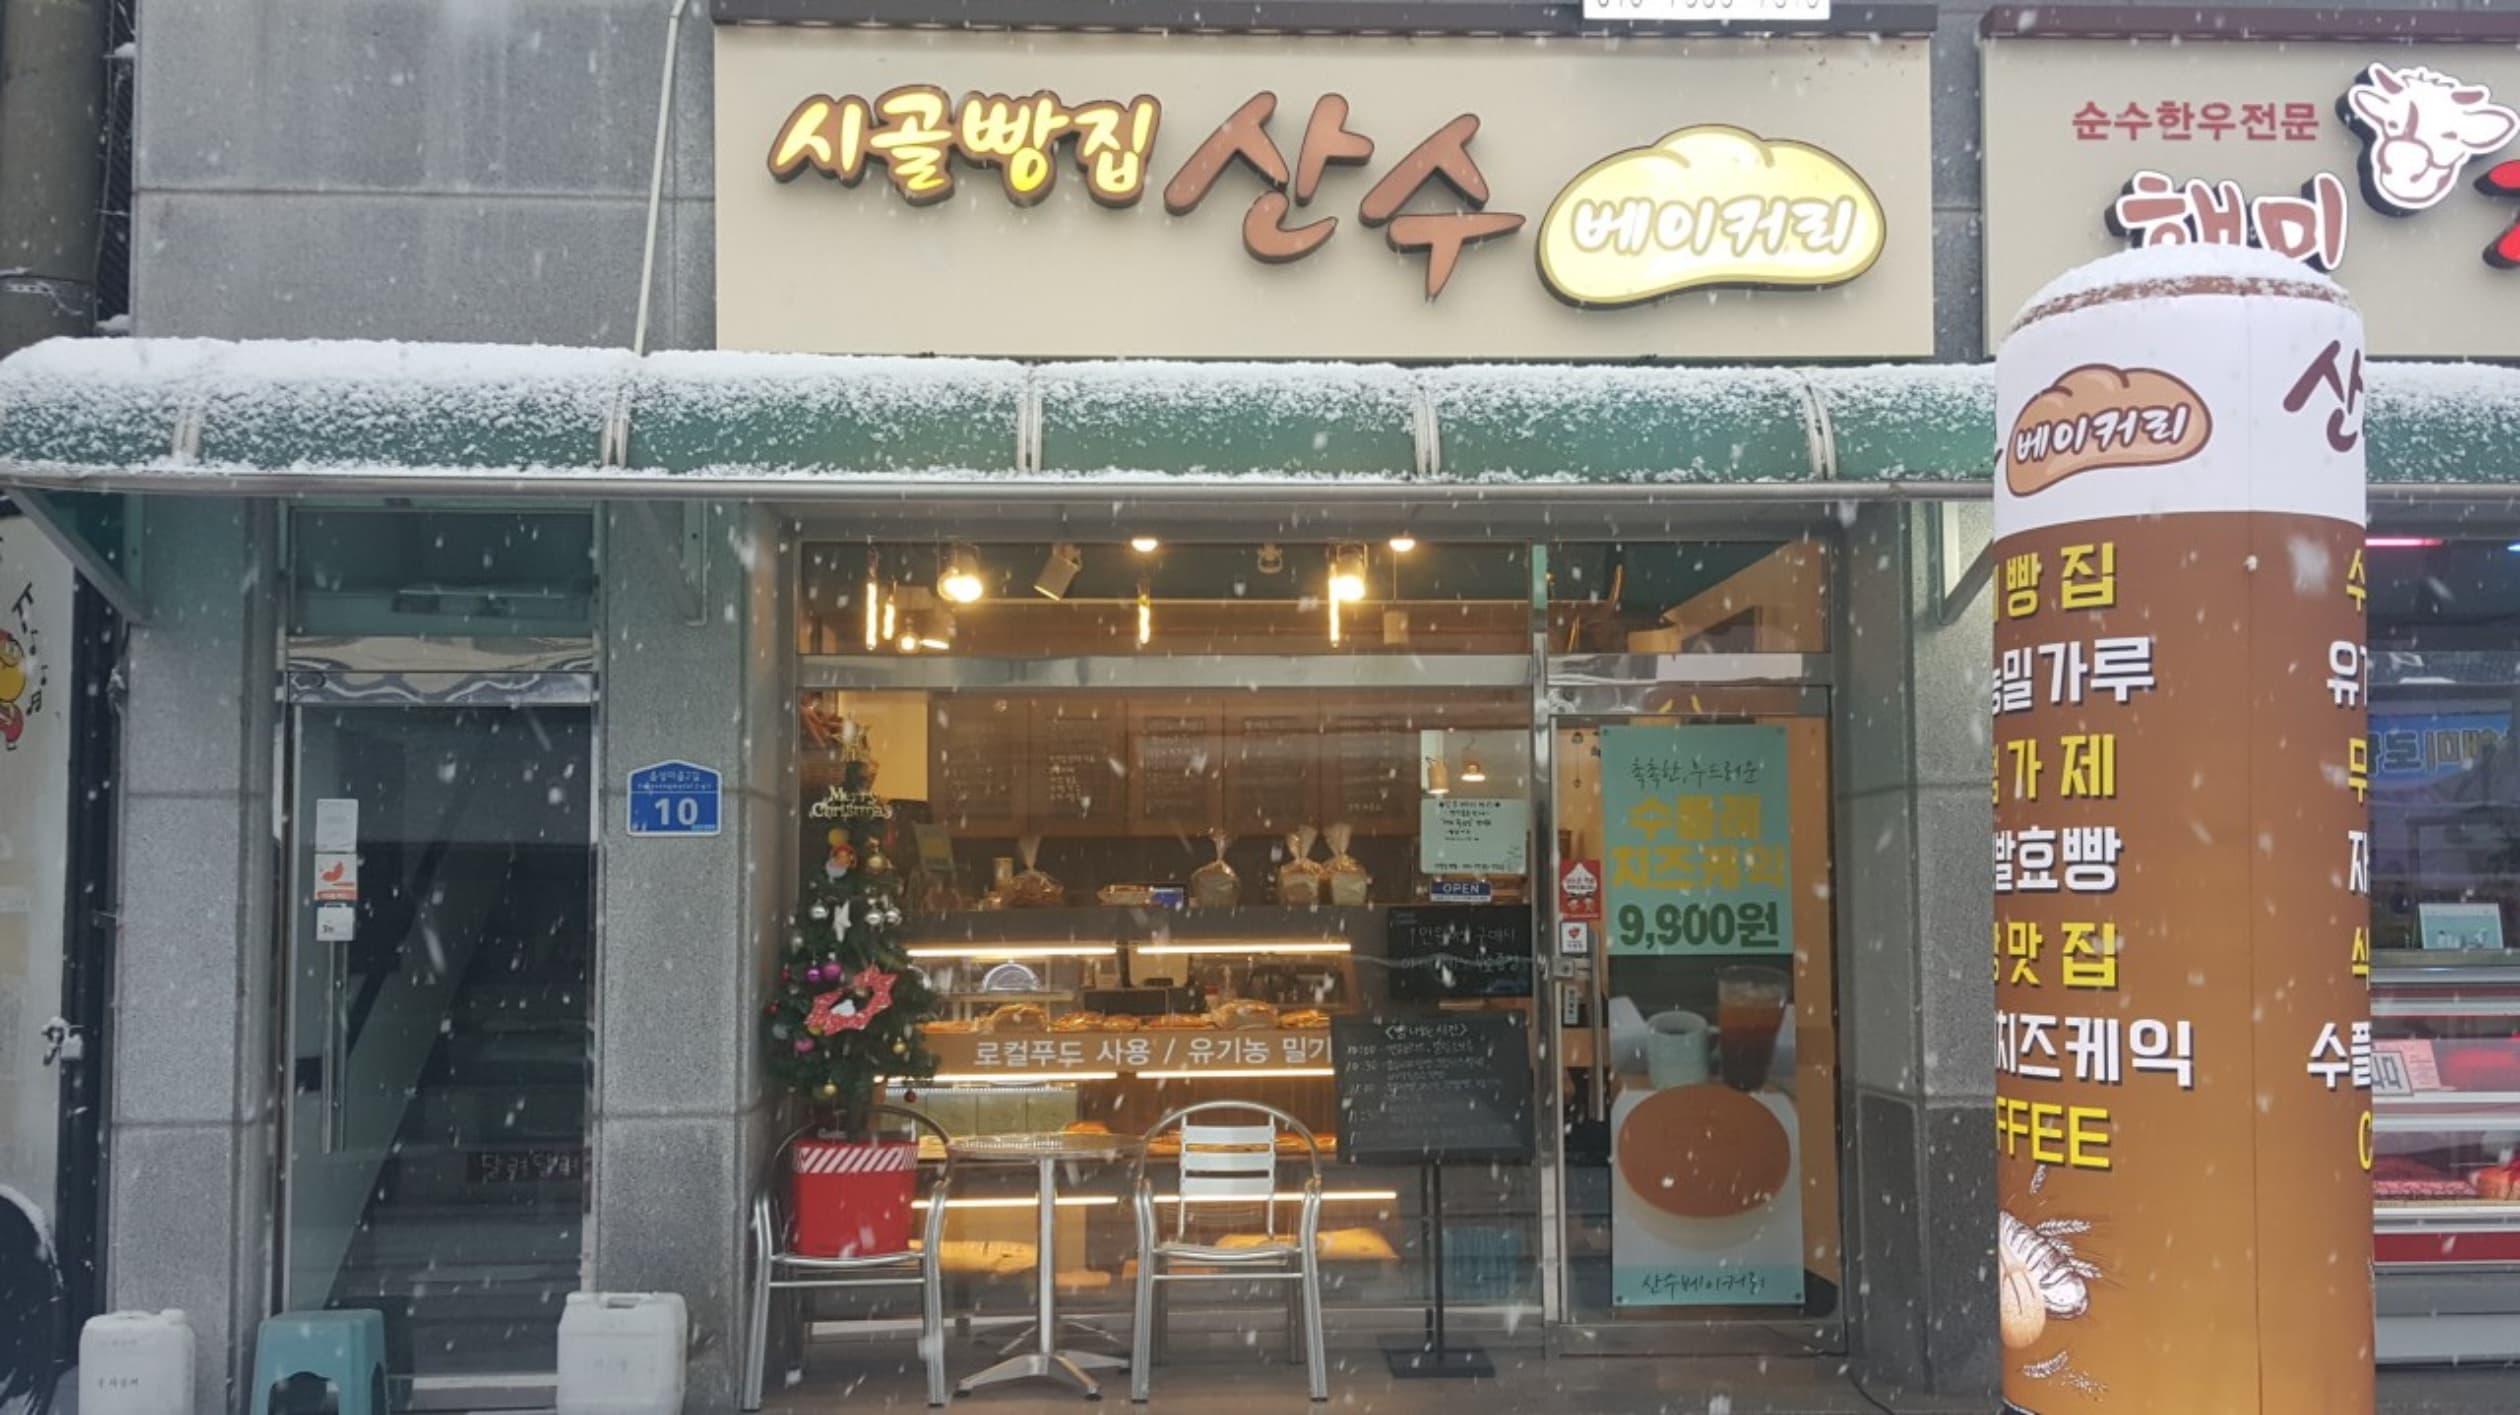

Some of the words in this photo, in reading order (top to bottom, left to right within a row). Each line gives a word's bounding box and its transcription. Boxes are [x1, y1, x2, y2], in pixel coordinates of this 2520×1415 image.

[2071, 100, 2319, 141] 순수한우전문
[770, 86, 1159, 204] 시골빵집
[1164, 91, 1525, 301] 산수
[1573, 195, 1857, 258] 베이커리
[2015, 403, 2190, 463] 베이커리
[655, 798, 698, 825] 10
[809, 801, 893, 820] Christmas
[1628, 795, 1761, 840] 수플레
[1611, 844, 1785, 890] 치즈케익
[1442, 883, 1480, 895] OPEN
[1619, 901, 1779, 949] 9,900원
[975, 1039, 1084, 1067] 로컬푸드
[1097, 1039, 1150, 1066] 사용
[1163, 1039, 1176, 1064] /
[1187, 1037, 1270, 1065] 유기농
